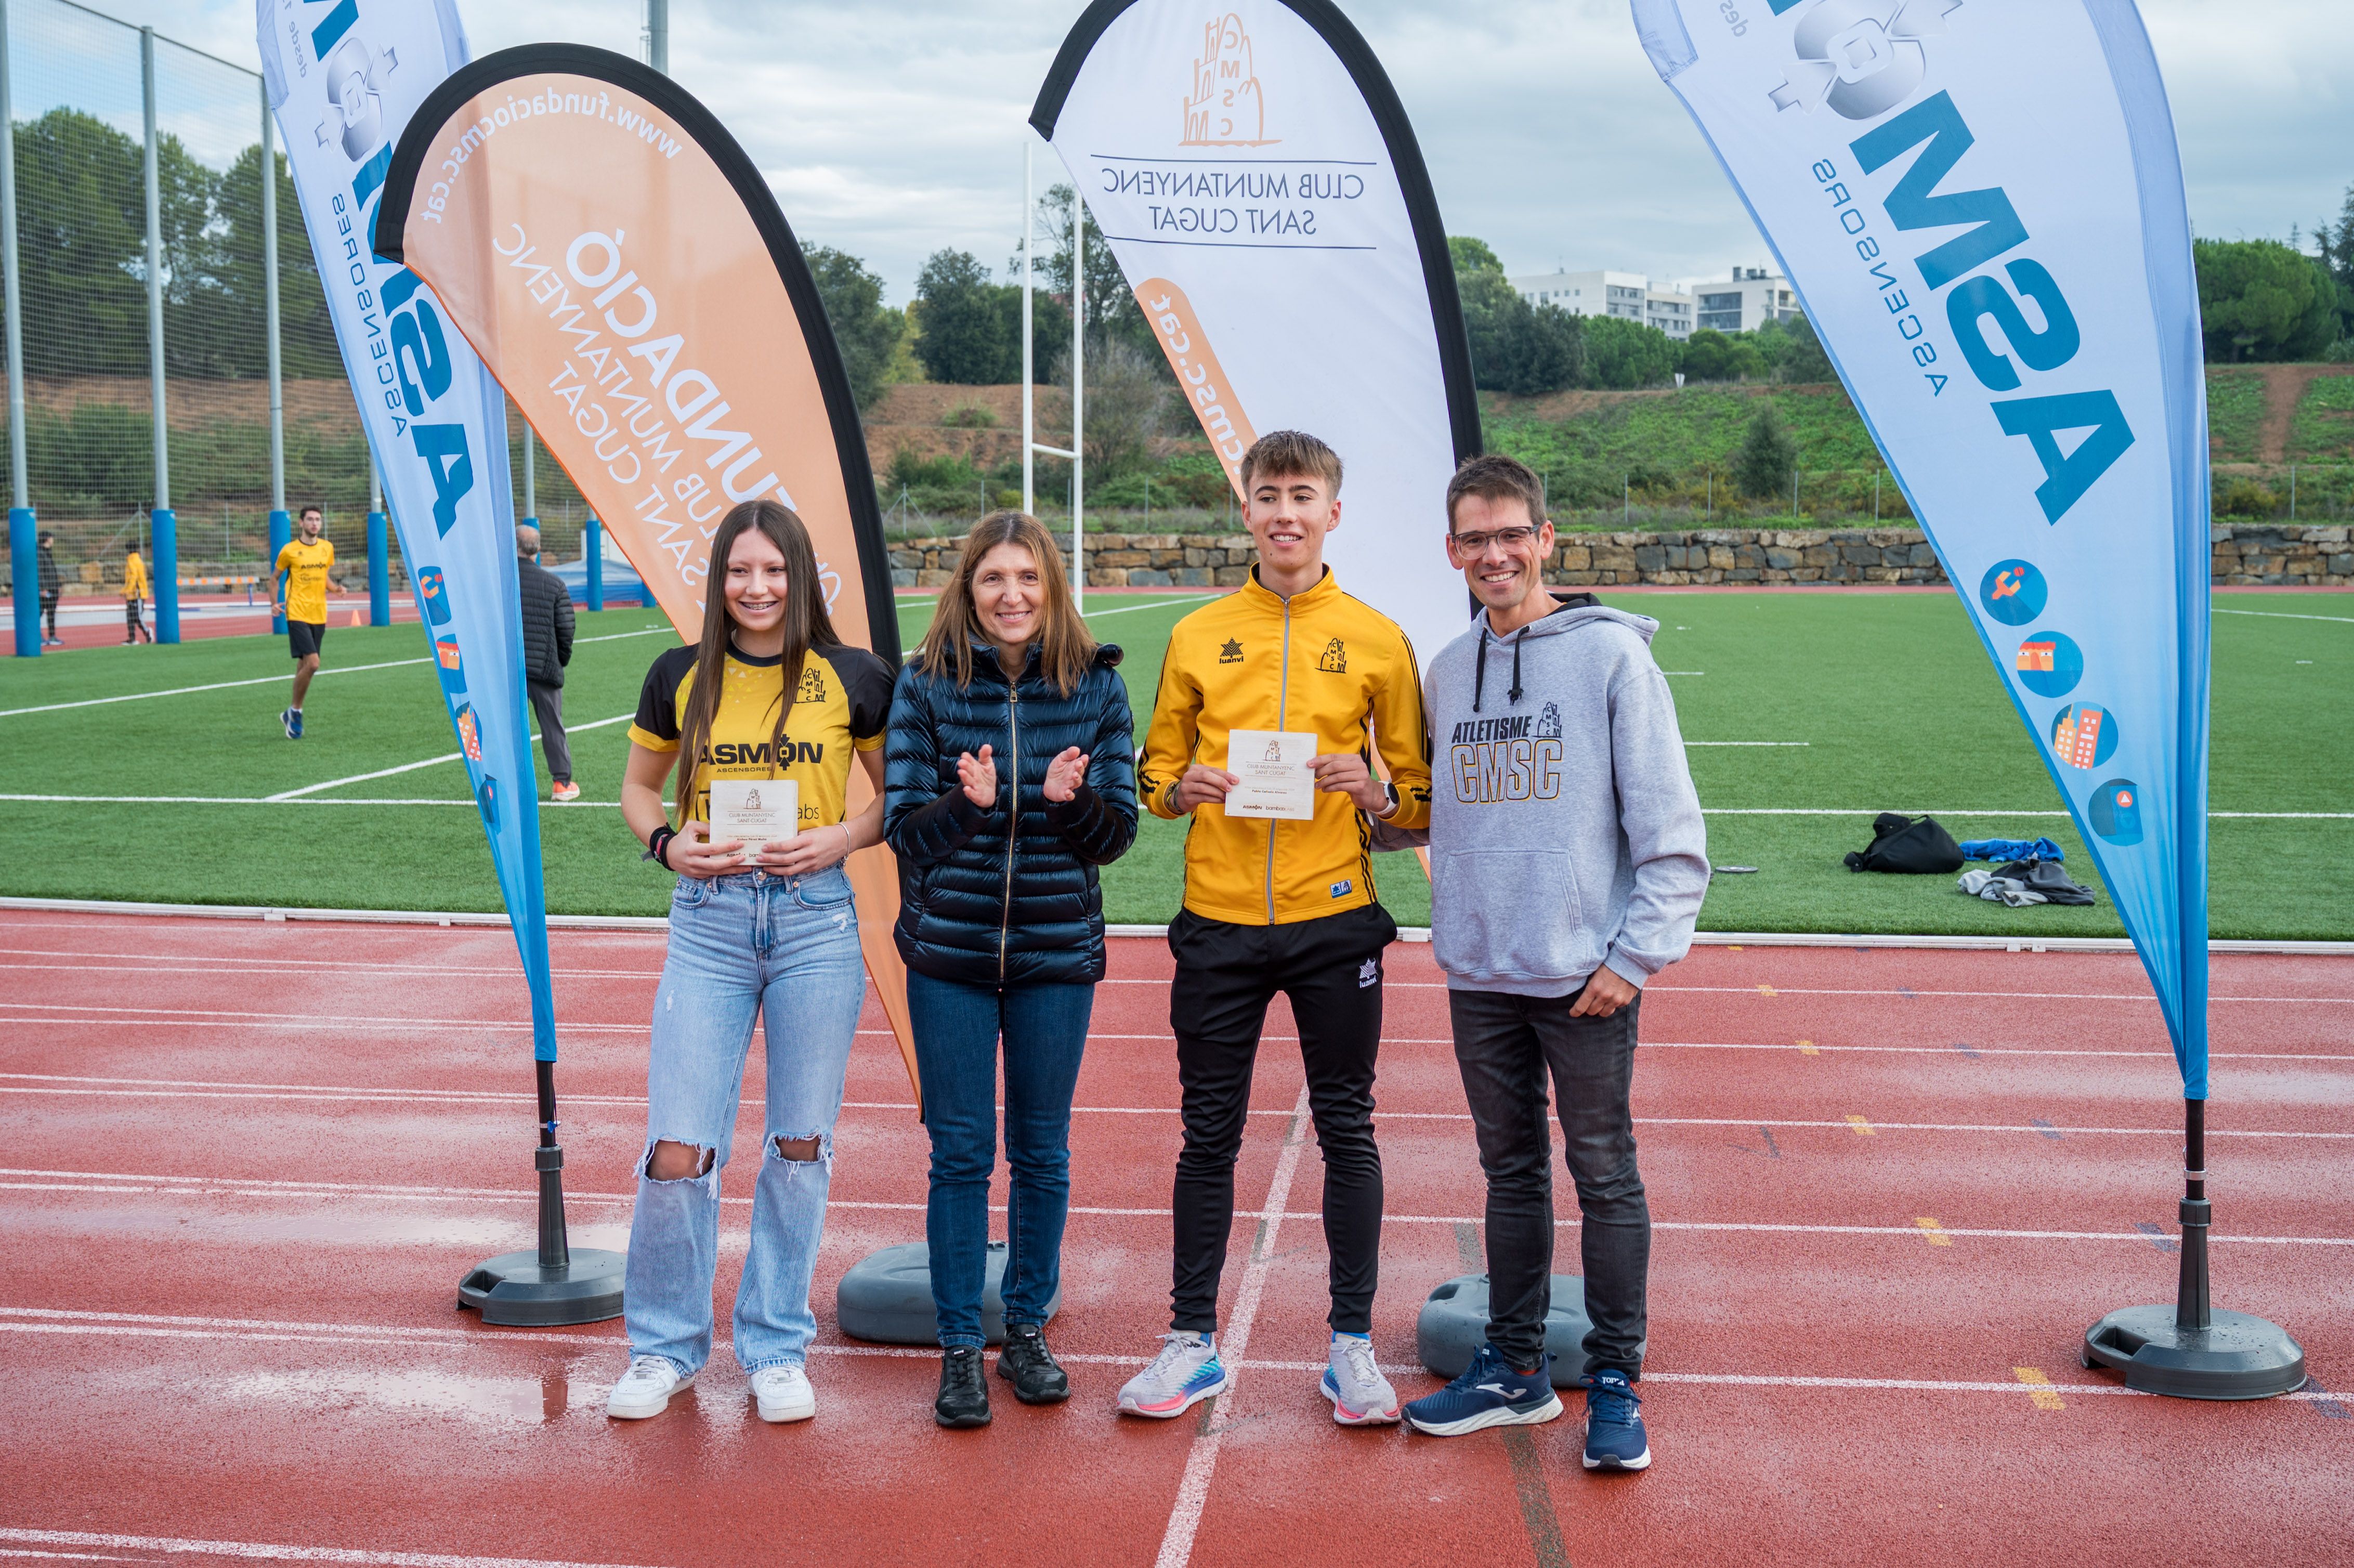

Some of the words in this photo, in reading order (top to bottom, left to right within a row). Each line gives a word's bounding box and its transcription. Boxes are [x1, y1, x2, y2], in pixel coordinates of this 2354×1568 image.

[1219, 656, 1244, 664] luanvi
[1451, 715, 1532, 743] ATLETISME
[1451, 738, 1563, 804] CMSC
[797, 803, 819, 820] abs
